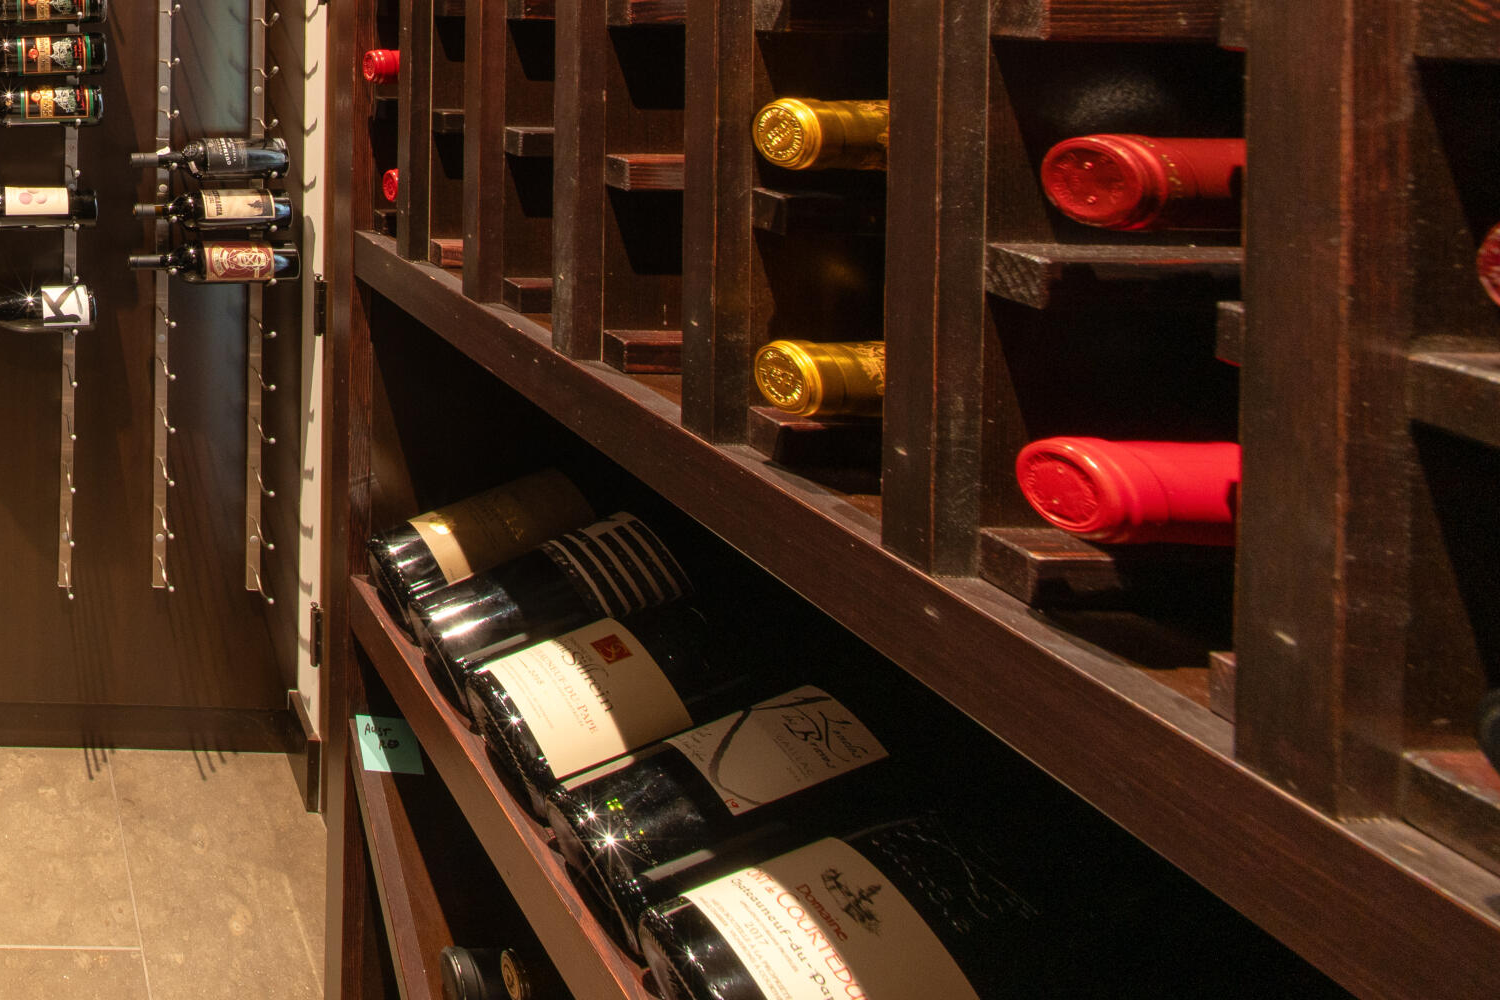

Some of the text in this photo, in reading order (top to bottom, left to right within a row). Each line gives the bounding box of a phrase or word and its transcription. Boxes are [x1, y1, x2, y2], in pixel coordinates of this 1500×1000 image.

[730, 877, 835, 1000] Chateauneuf-du-Pa
[743, 920, 770, 948] 2017
[796, 882, 849, 941] Domaine
